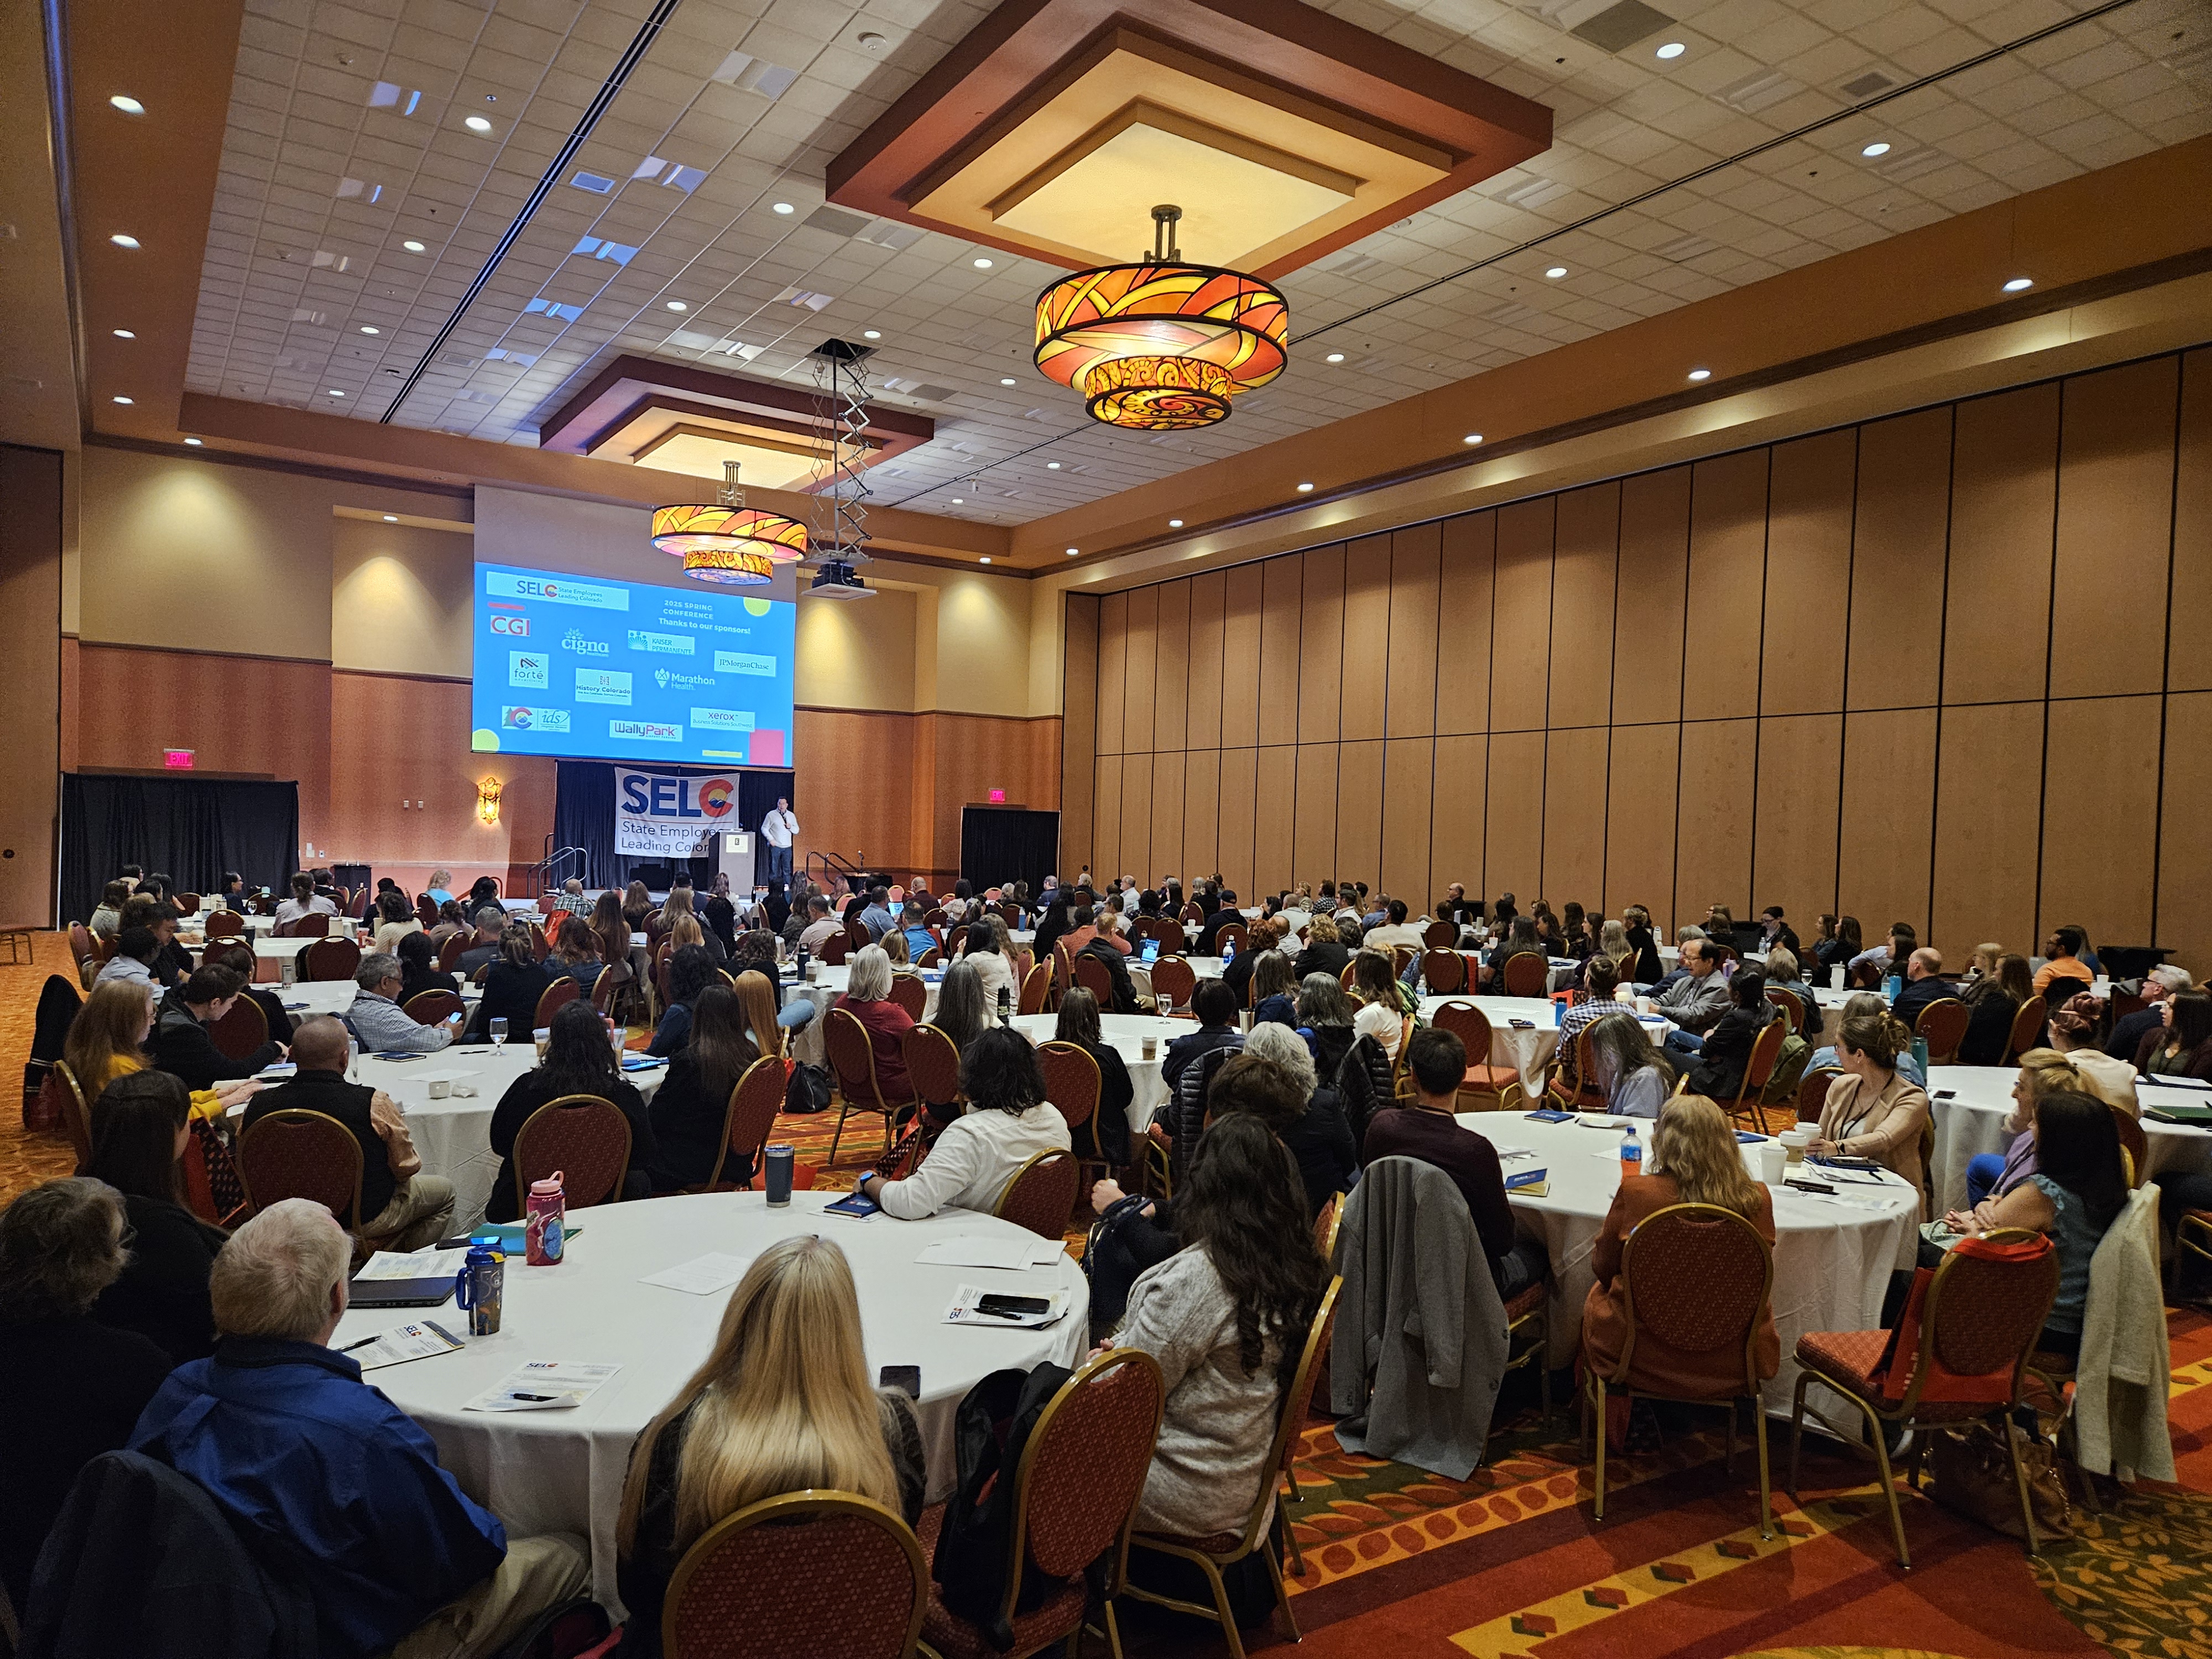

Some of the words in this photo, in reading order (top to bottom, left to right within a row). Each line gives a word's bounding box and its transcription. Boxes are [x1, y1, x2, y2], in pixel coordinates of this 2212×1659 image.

[663, 608, 713, 619] CONFERENCE
[685, 602, 713, 611] SPRING
[491, 616, 530, 635] CGI
[659, 618, 687, 627] Thanks
[714, 625, 750, 634] sponsors!
[561, 638, 609, 655] cigna
[719, 659, 769, 670] JPMorganChase
[514, 669, 544, 679] forté
[671, 673, 715, 685] Marathon
[708, 712, 734, 721] xerox
[614, 722, 675, 737] WallyPark
[621, 774, 734, 818] SELC
[623, 821, 655, 835] State
[660, 825, 722, 840] Employe
[622, 837, 671, 854] Leading
[675, 841, 708, 852] Color
